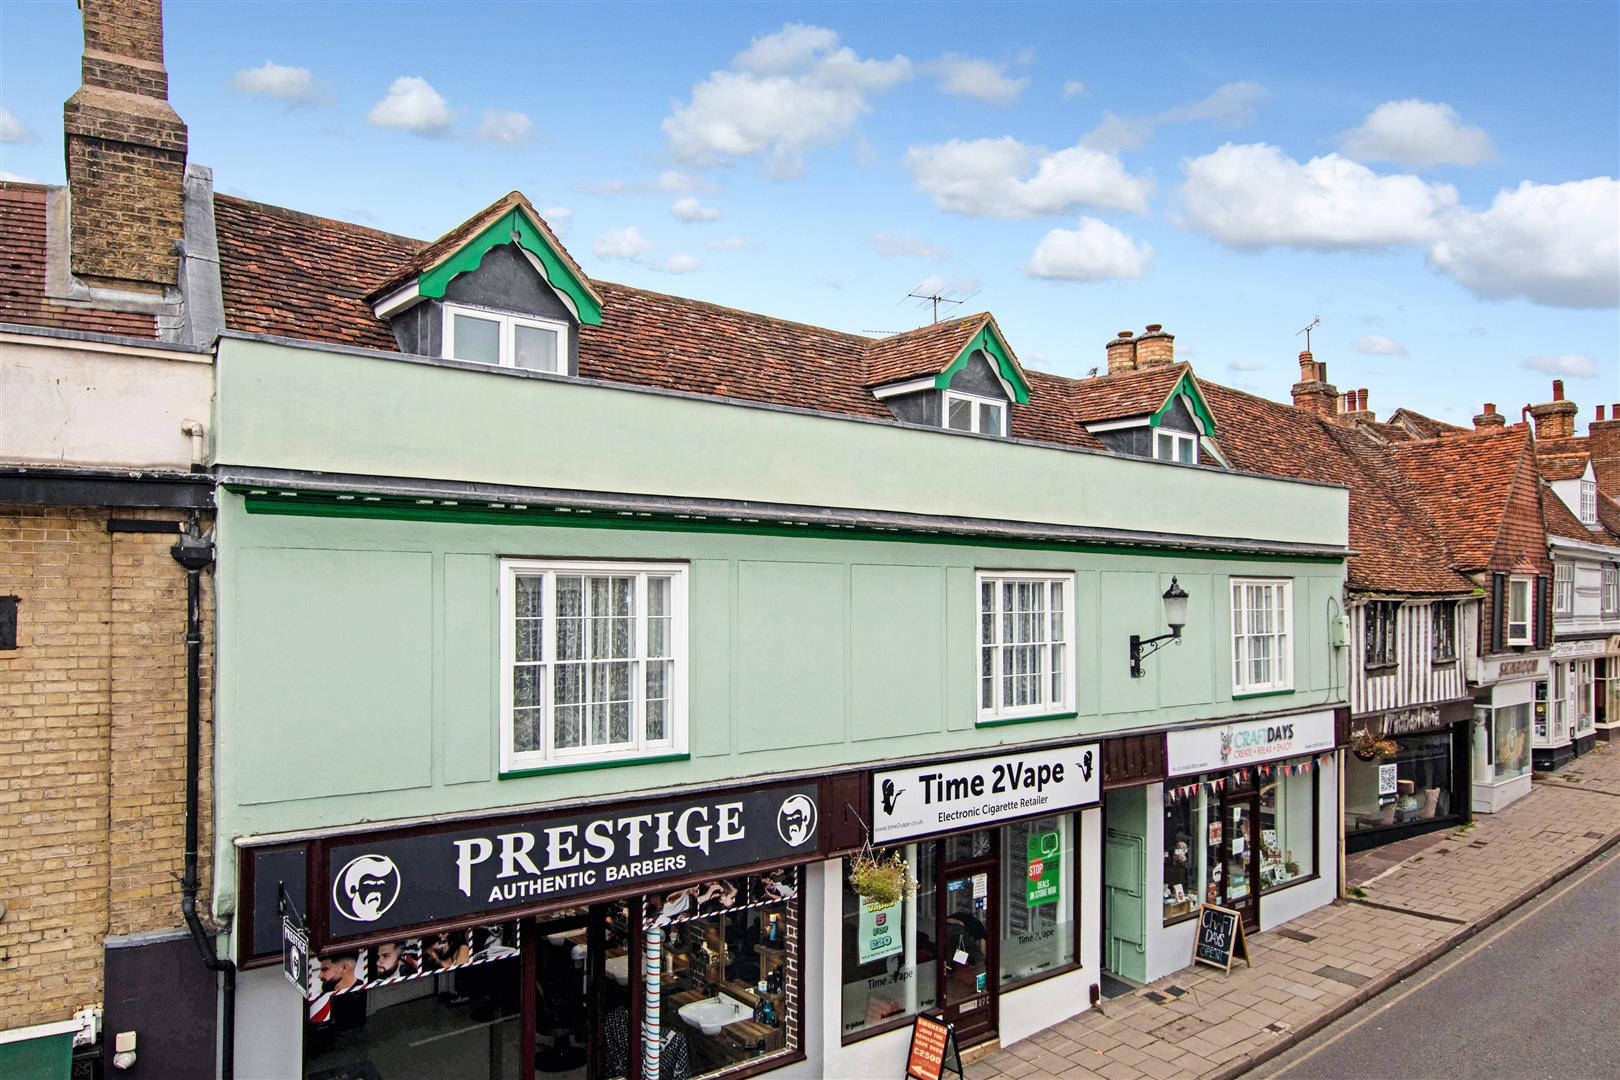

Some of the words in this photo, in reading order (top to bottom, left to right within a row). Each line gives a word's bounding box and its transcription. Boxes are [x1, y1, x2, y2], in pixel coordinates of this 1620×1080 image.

[1233, 724, 1294, 749] CRAFTDAYS
[918, 773, 985, 805] Time
[991, 761, 1065, 794] 2Vape
[938, 807, 980, 823] Electronic
[982, 800, 1018, 816] Cigarette
[1020, 795, 1049, 808] Retailer
[453, 801, 746, 897] PRESTIGE
[488, 869, 597, 903] AUTHENTIC
[605, 855, 688, 882] BARBERS
[875, 913, 887, 927] 5
[1018, 935, 1033, 946] Time
[1205, 929, 1225, 947] DAYS
[868, 977, 887, 990] Time
[917, 1018, 948, 1035] SMOKERS
[919, 1028, 932, 1037] JOIN
[913, 1047, 941, 1065] £2500
